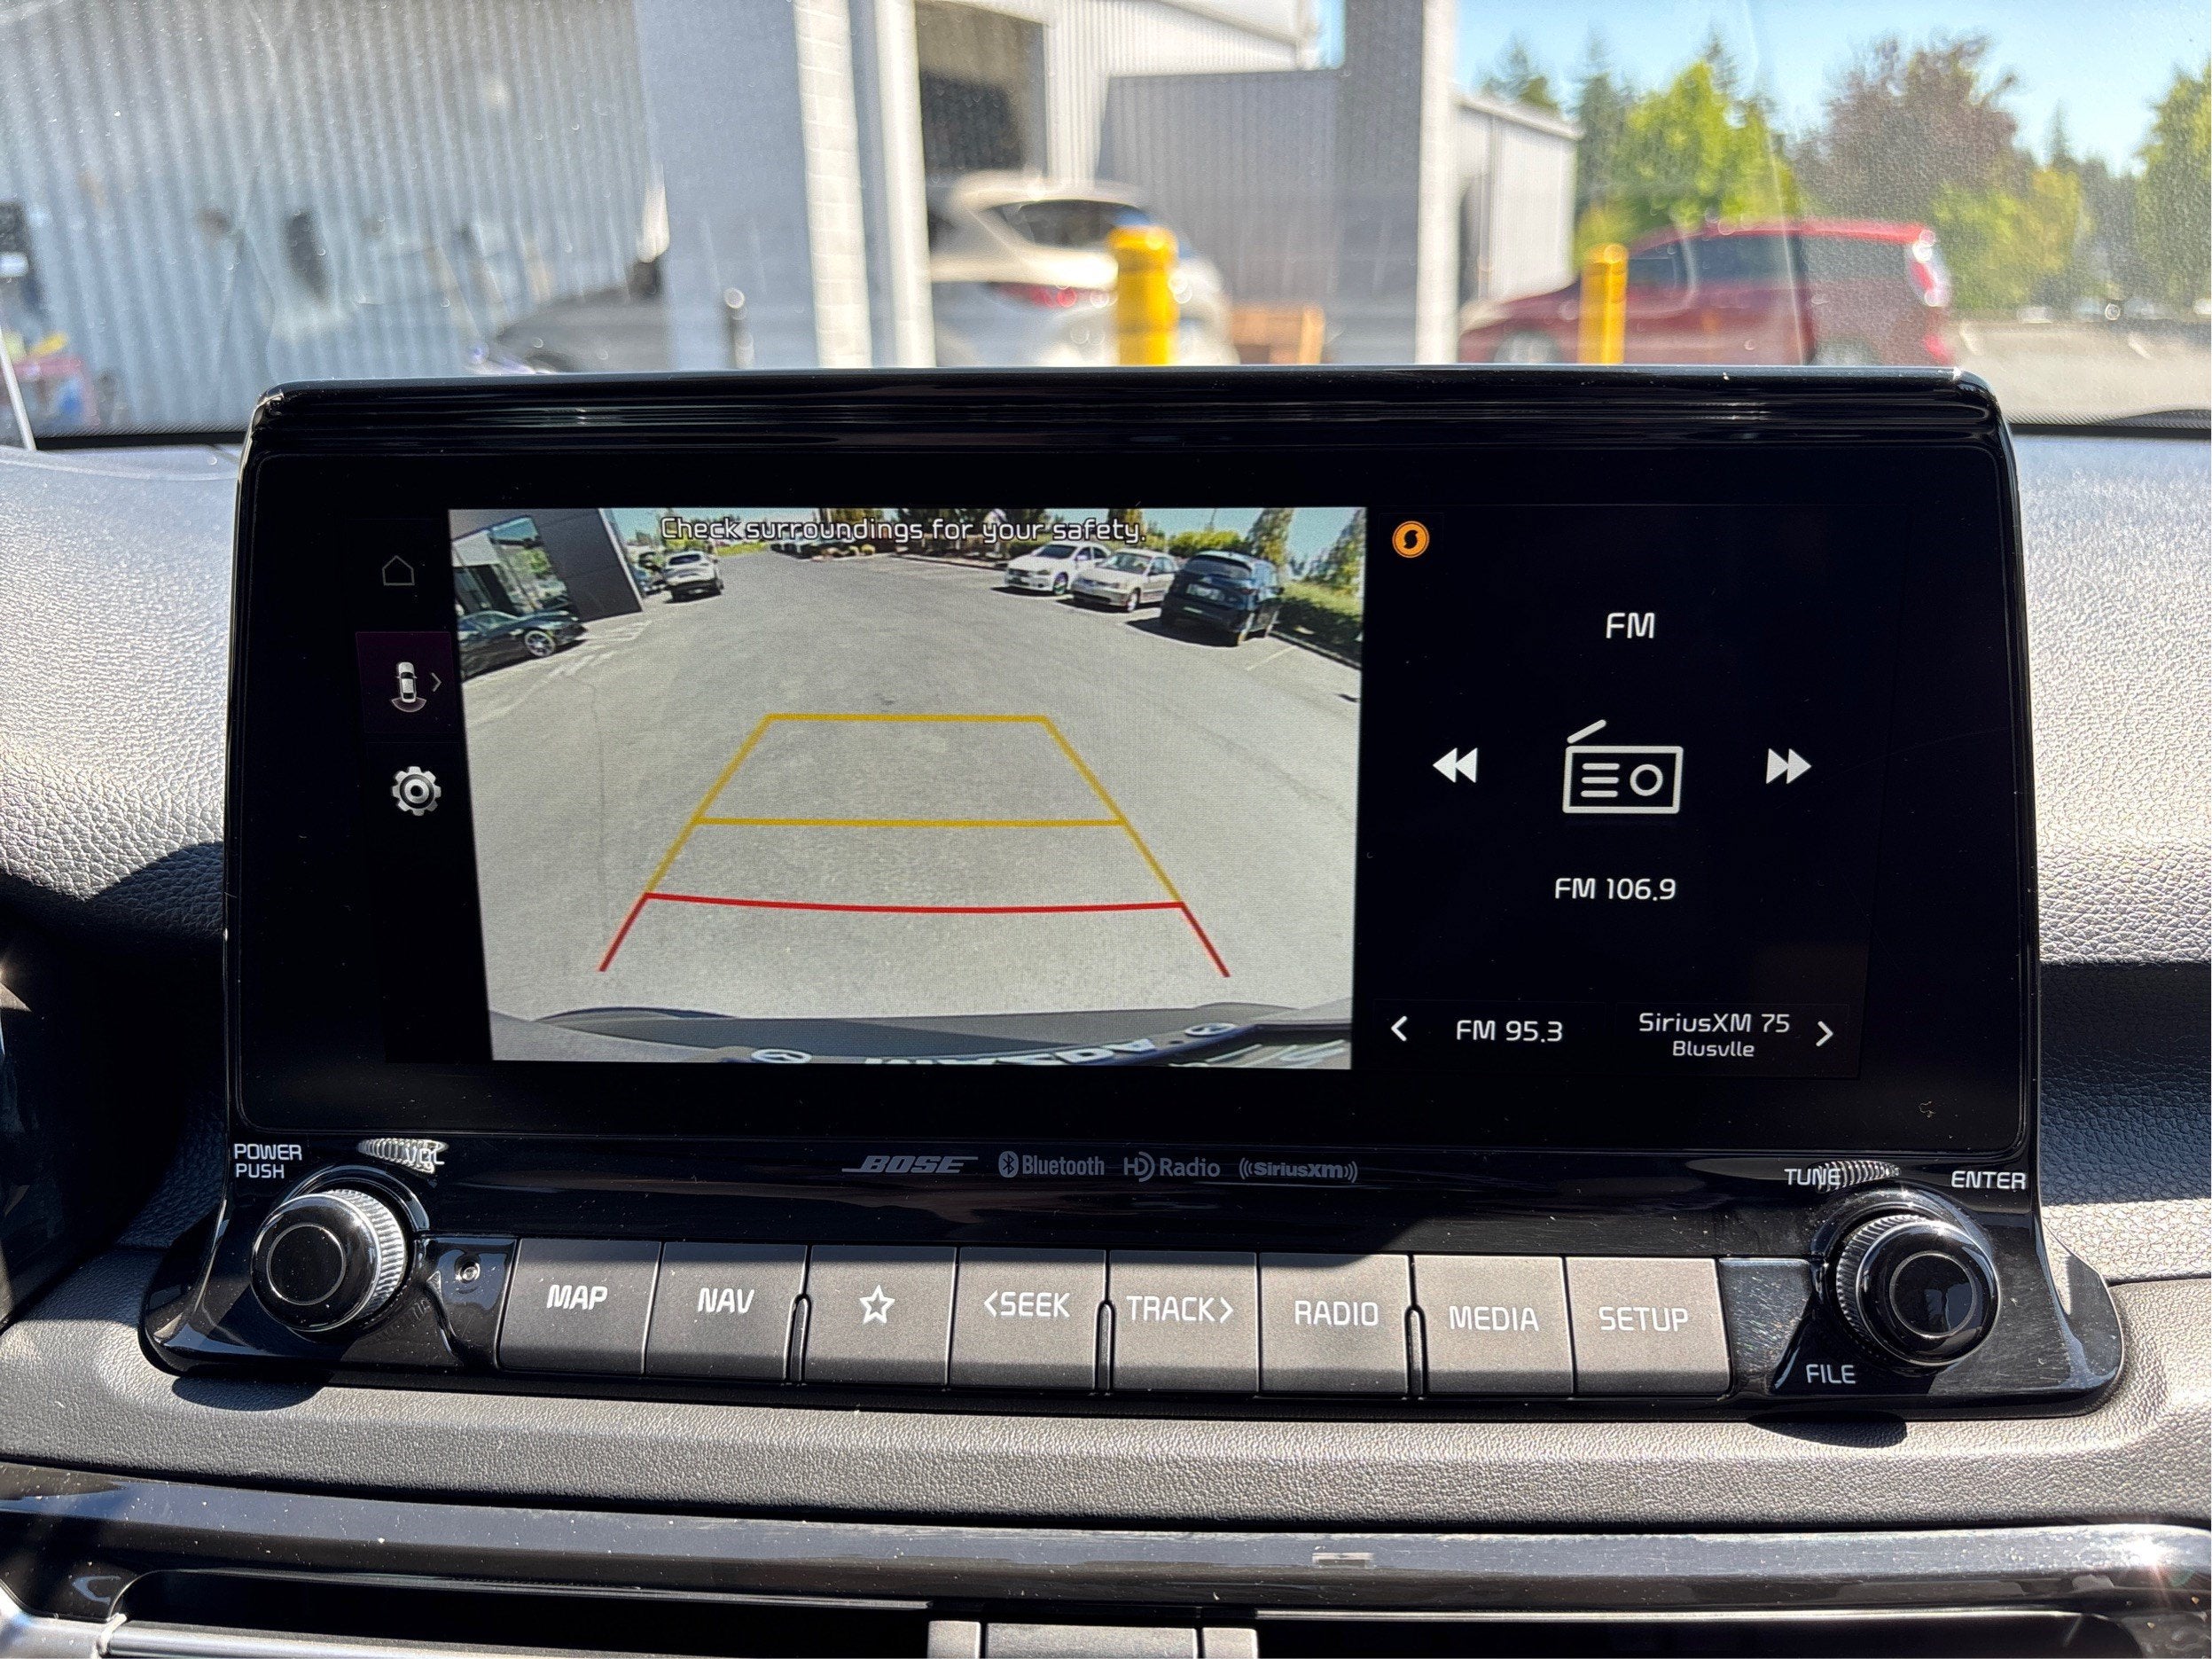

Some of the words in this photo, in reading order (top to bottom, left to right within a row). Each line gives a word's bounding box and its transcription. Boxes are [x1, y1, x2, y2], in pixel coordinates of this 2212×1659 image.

[661, 517, 740, 539] Check
[746, 517, 922, 543] surroundings
[932, 518, 973, 540] for
[982, 523, 1046, 543] your
[1052, 518, 1146, 544] safety.
[1606, 612, 1655, 639] FM
[1555, 878, 1596, 900] FM
[1606, 879, 1677, 903] 106.9
[1457, 1021, 1496, 1041] FM
[1505, 1021, 1563, 1044] 95.3
[1638, 1013, 1752, 1034] SiriusXM
[1761, 1013, 1791, 1034] 75
[1672, 1041, 1755, 1058] Blusvlle
[234, 1143, 303, 1161] POWER
[236, 1162, 285, 1179] PUSH
[842, 1155, 979, 1174] BOSE
[1022, 1154, 1106, 1177] Bluetooth
[1160, 1157, 1222, 1178] Radio
[1785, 1168, 1842, 1186] TUNE
[1951, 1170, 2027, 1191] ENTER
[546, 1284, 609, 1311] MAP
[698, 1287, 755, 1316] NAV
[1294, 1299, 1380, 1327] RADIO
[1448, 1305, 1540, 1333] MEDIA
[1598, 1306, 1690, 1333] SETUP
[1806, 1364, 1856, 1385] FILE
